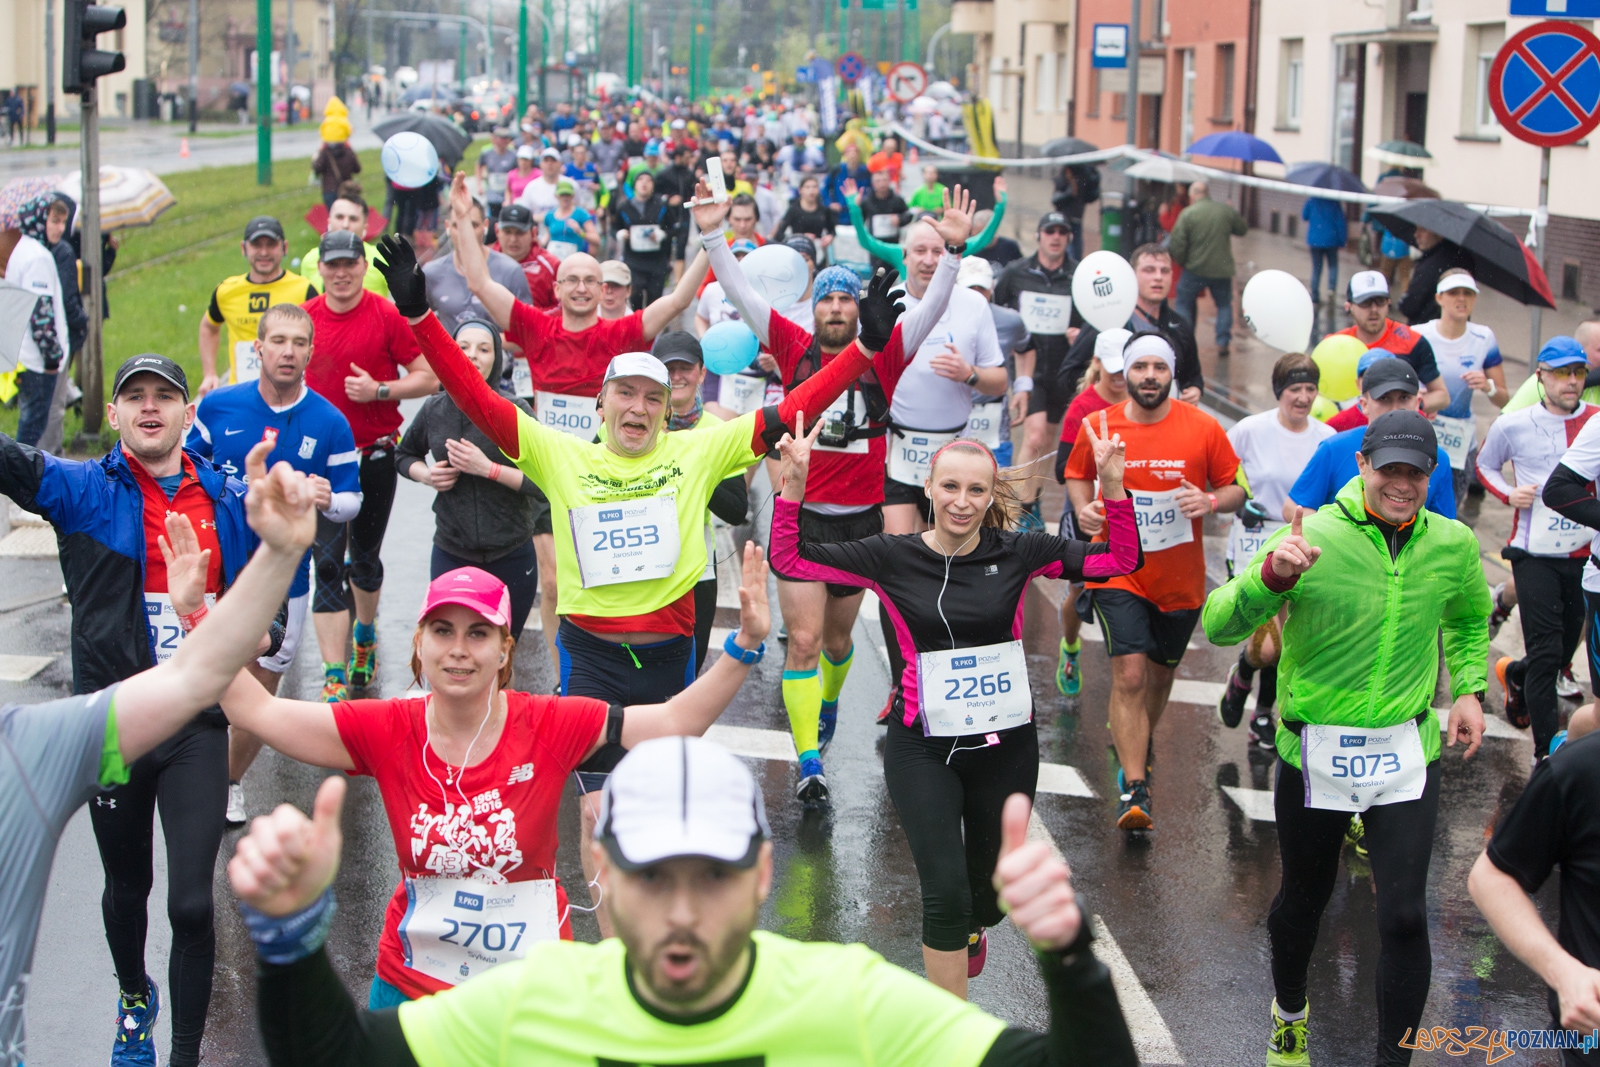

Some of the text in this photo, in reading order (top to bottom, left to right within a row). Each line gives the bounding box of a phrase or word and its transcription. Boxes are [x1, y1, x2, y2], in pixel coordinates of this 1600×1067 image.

[1030, 306, 1062, 318] 7822
[545, 410, 592, 430] 13400
[1382, 434, 1424, 442] SALOMON
[1149, 460, 1186, 468] ZONE
[602, 512, 620, 520] 9.PKO
[1548, 516, 1586, 530] 262
[593, 524, 660, 552] 2653
[612, 550, 643, 558] Jarosław
[944, 672, 1012, 700] 2266
[966, 700, 996, 708] Patrycja
[1332, 752, 1402, 778] 5073
[472, 788, 500, 805] 1966
[474, 798, 502, 815] 2016
[458, 896, 479, 907] 9.PKO
[438, 918, 526, 952] 2707
